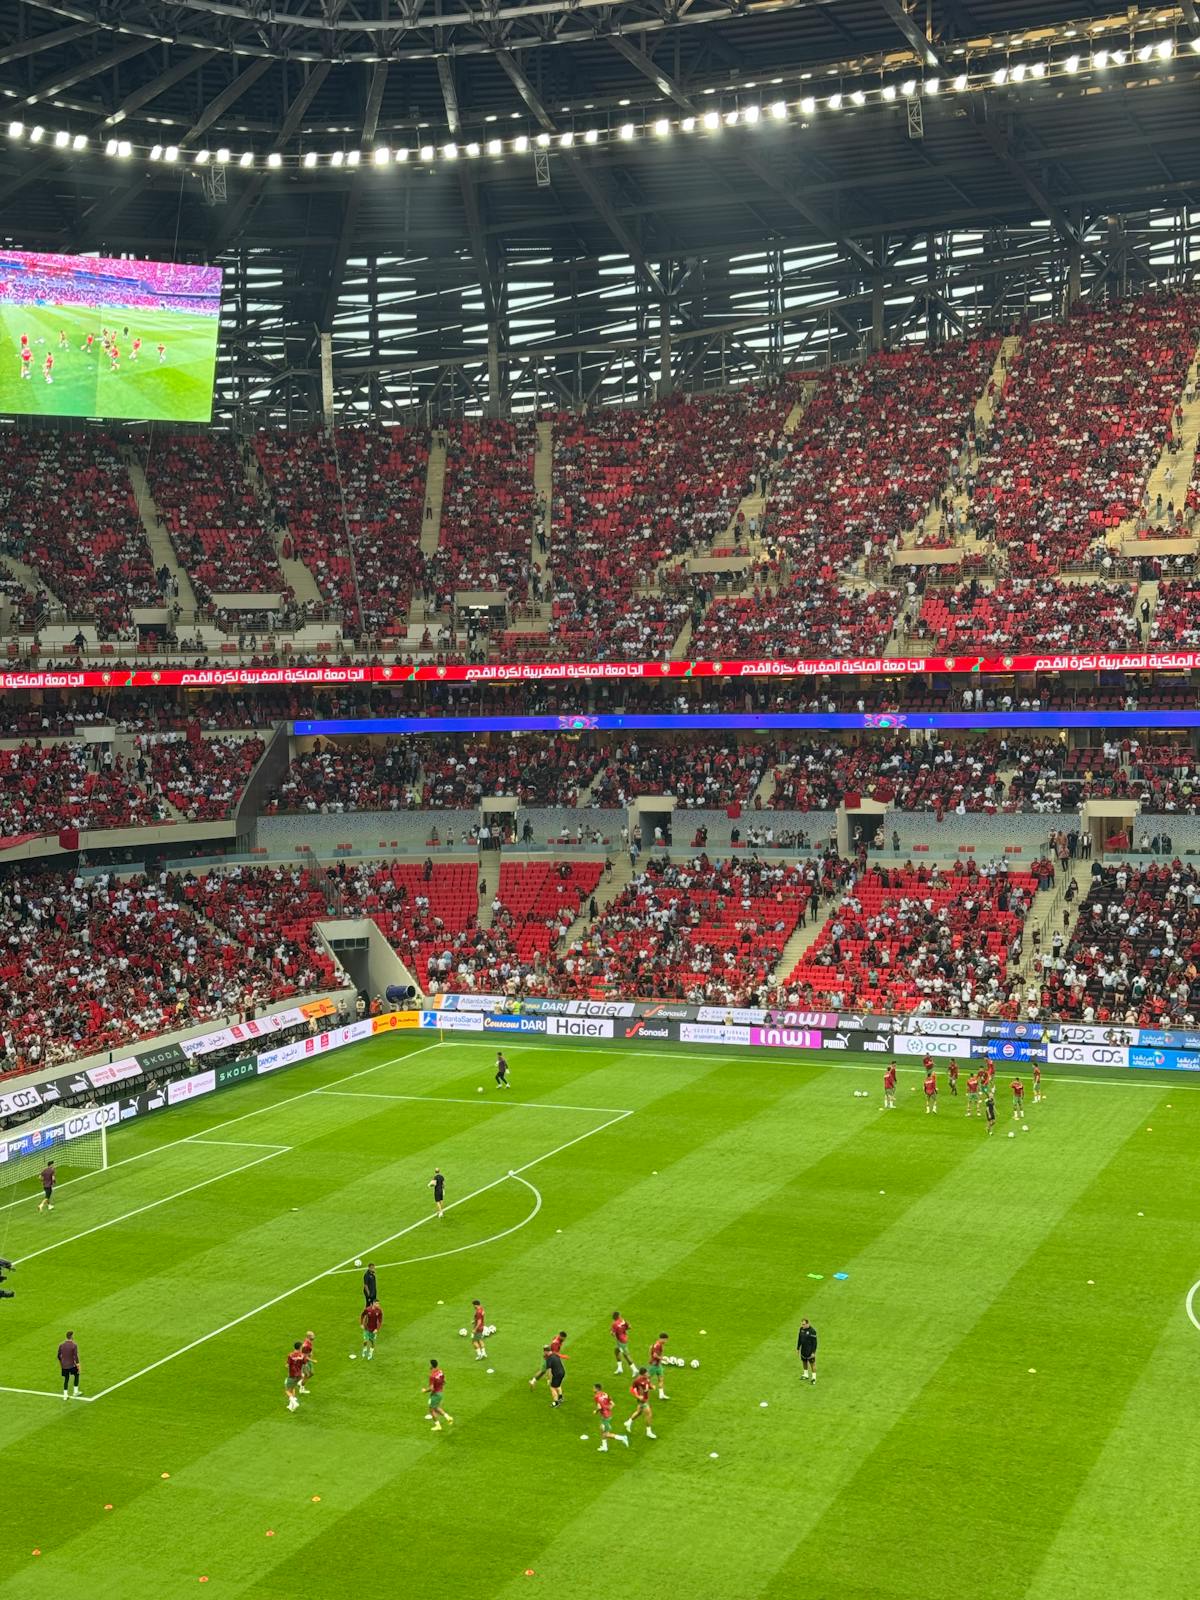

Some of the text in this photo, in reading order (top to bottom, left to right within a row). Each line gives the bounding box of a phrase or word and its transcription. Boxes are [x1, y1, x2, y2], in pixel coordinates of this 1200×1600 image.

[741, 662, 772, 675] القدم
[797, 661, 840, 675] المغربية
[842, 661, 881, 674] الملكية
[1034, 657, 1068, 671] القدم
[1070, 656, 1096, 671] لكرة
[1098, 656, 1147, 670] المغربية
[1148, 655, 1194, 669] الملكية
[181, 672, 213, 685] القدم
[214, 671, 239, 684] لكرة
[239, 670, 283, 684] المغربية
[284, 669, 322, 683] الملكية
[466, 667, 497, 680] القدم
[497, 667, 522, 680] لكرة
[522, 666, 566, 679] المغربية
[567, 665, 604, 679] الملكية
[541, 1002, 567, 1011] DARI
[575, 1002, 625, 1016] Haier
[521, 1019, 546, 1031] DARI
[556, 1019, 604, 1036] Haier
[939, 1024, 971, 1033] OCP
[984, 1026, 1009, 1034] PEPSI
[638, 1028, 669, 1038] Sonasid
[925, 1043, 958, 1053] OCP
[972, 1045, 996, 1054] PEPSI
[1021, 1048, 1046, 1057] PEPSI
[1053, 1047, 1084, 1062] CDG
[1092, 1049, 1123, 1064] CDG
